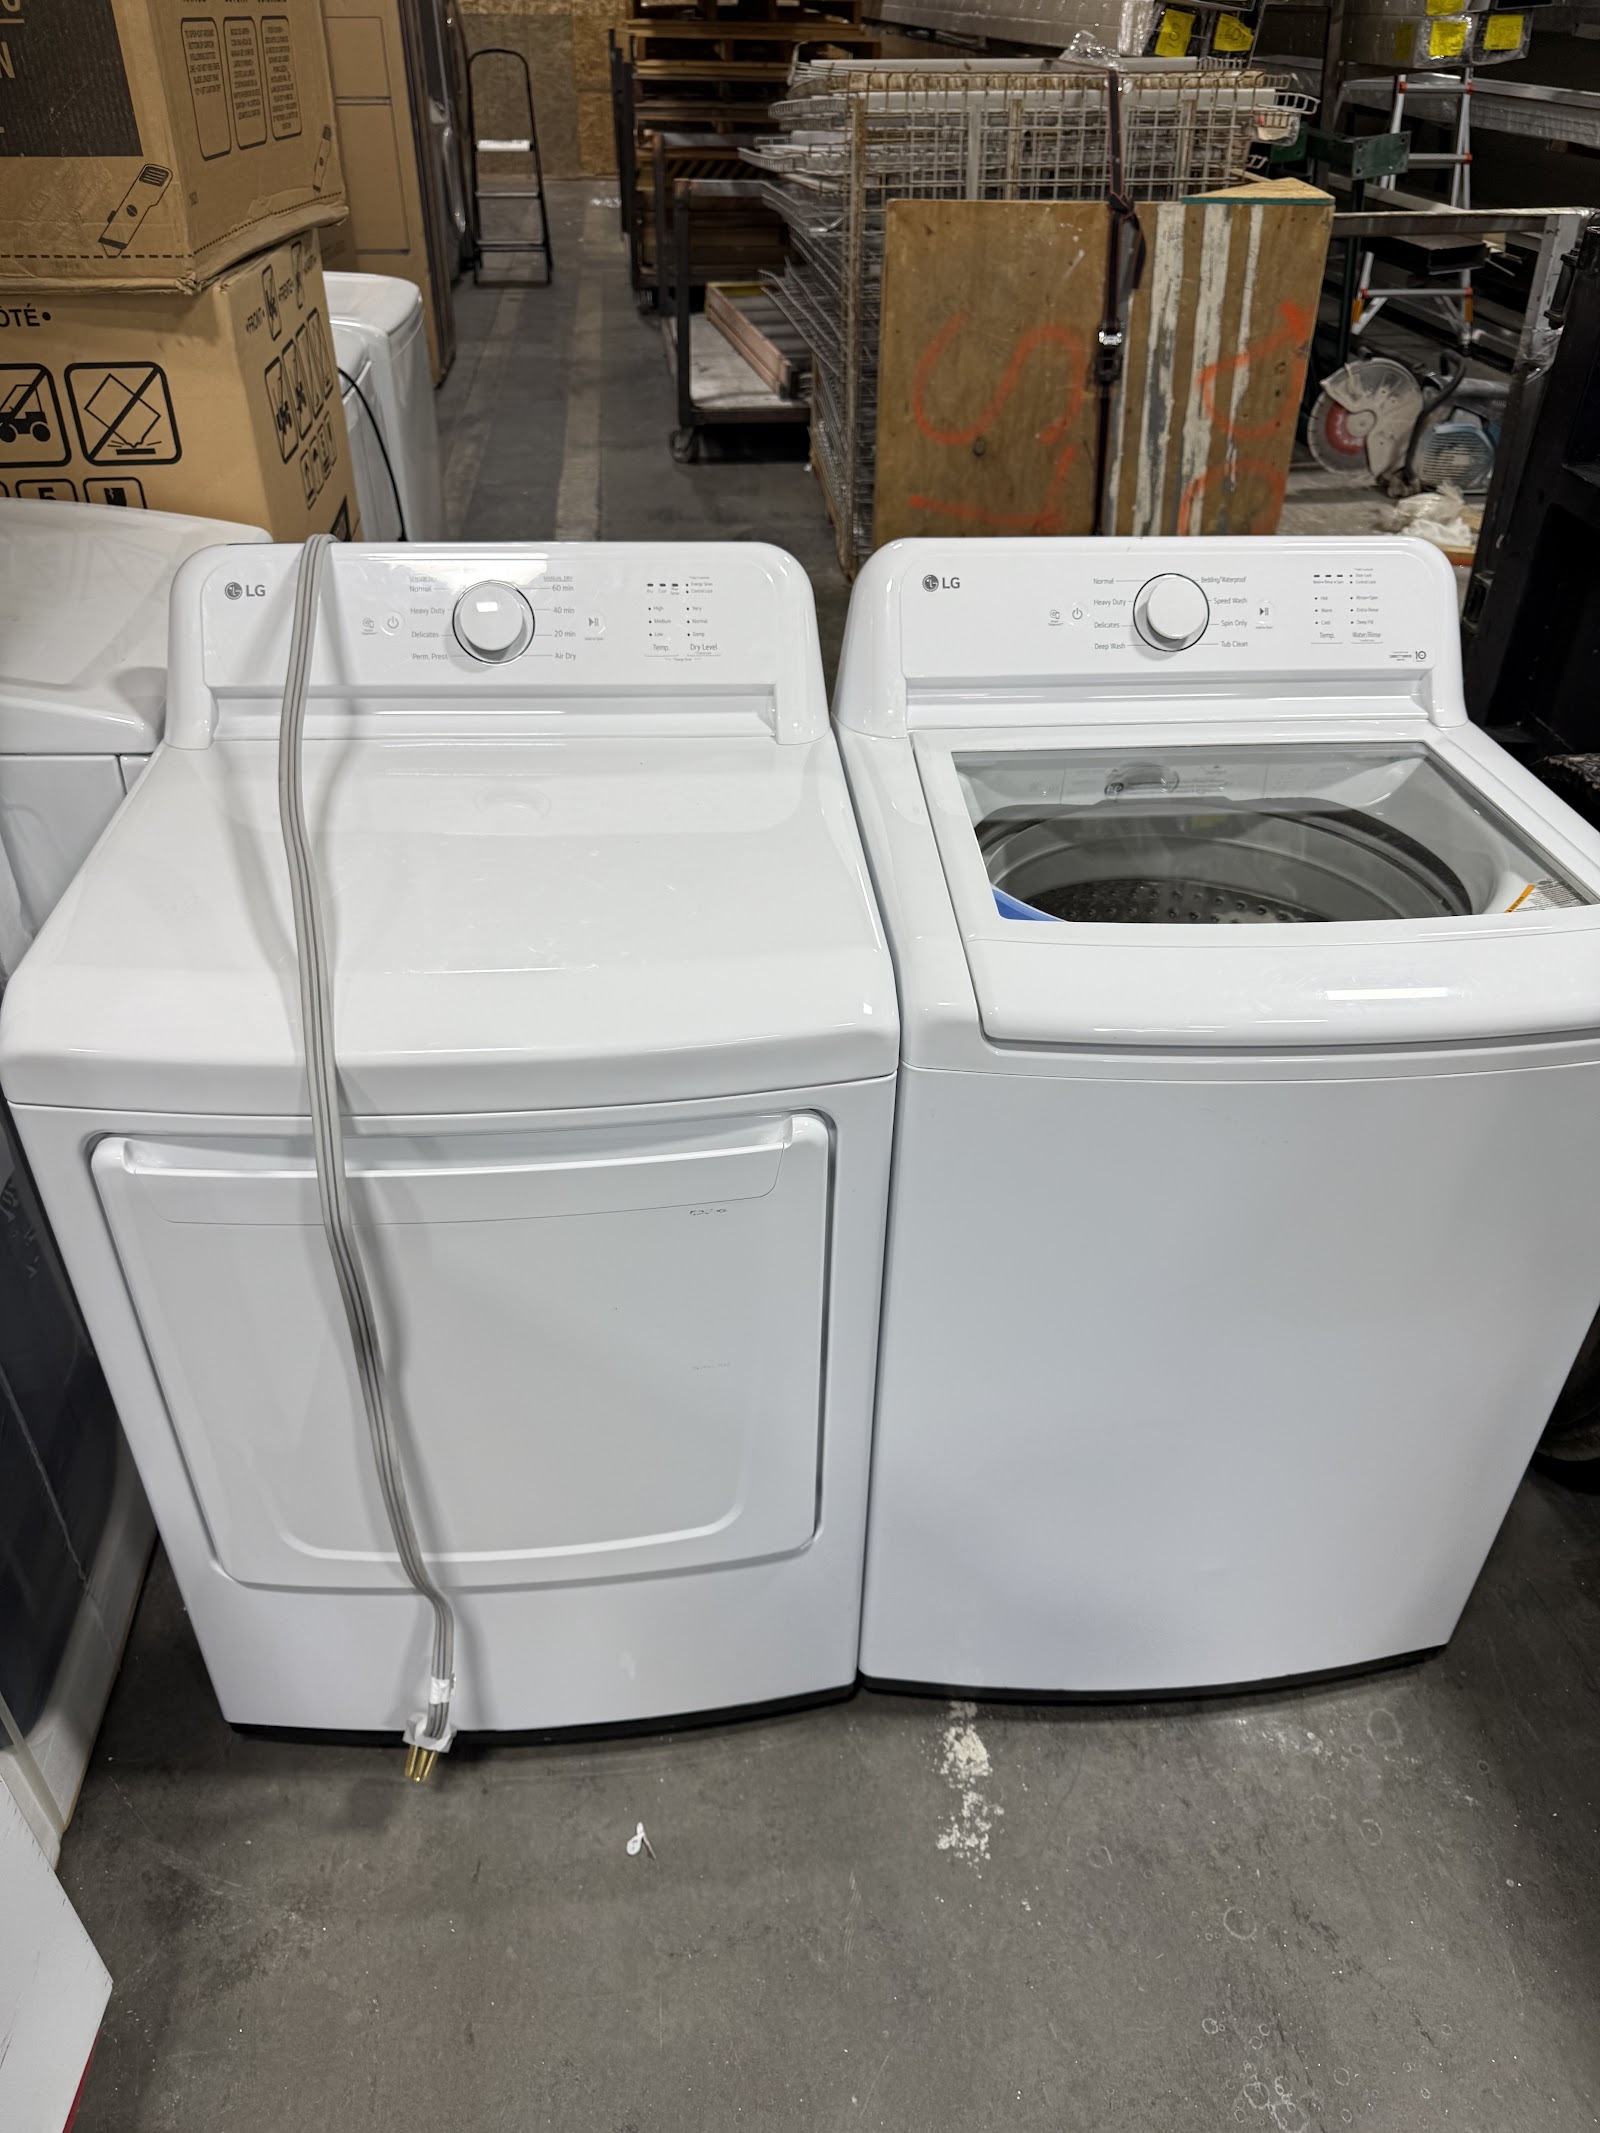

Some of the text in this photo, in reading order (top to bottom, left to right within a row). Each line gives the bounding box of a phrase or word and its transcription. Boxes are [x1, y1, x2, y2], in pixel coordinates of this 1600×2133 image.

[942, 577, 961, 589] LG
[245, 584, 266, 597] LG
[1094, 598, 1126, 607] Heavy Duty
[1214, 597, 1231, 606] Speed
[410, 607, 446, 616] Heavy Duty
[1094, 621, 1120, 629] Delicates
[1221, 619, 1234, 628] Spin
[1235, 619, 1247, 628] Only
[411, 630, 440, 639] Delicates
[653, 644, 670, 652] Temp.
[690, 644, 701, 652] Dry
[1094, 642, 1109, 651] Deep
[566, 652, 576, 661] Dry
